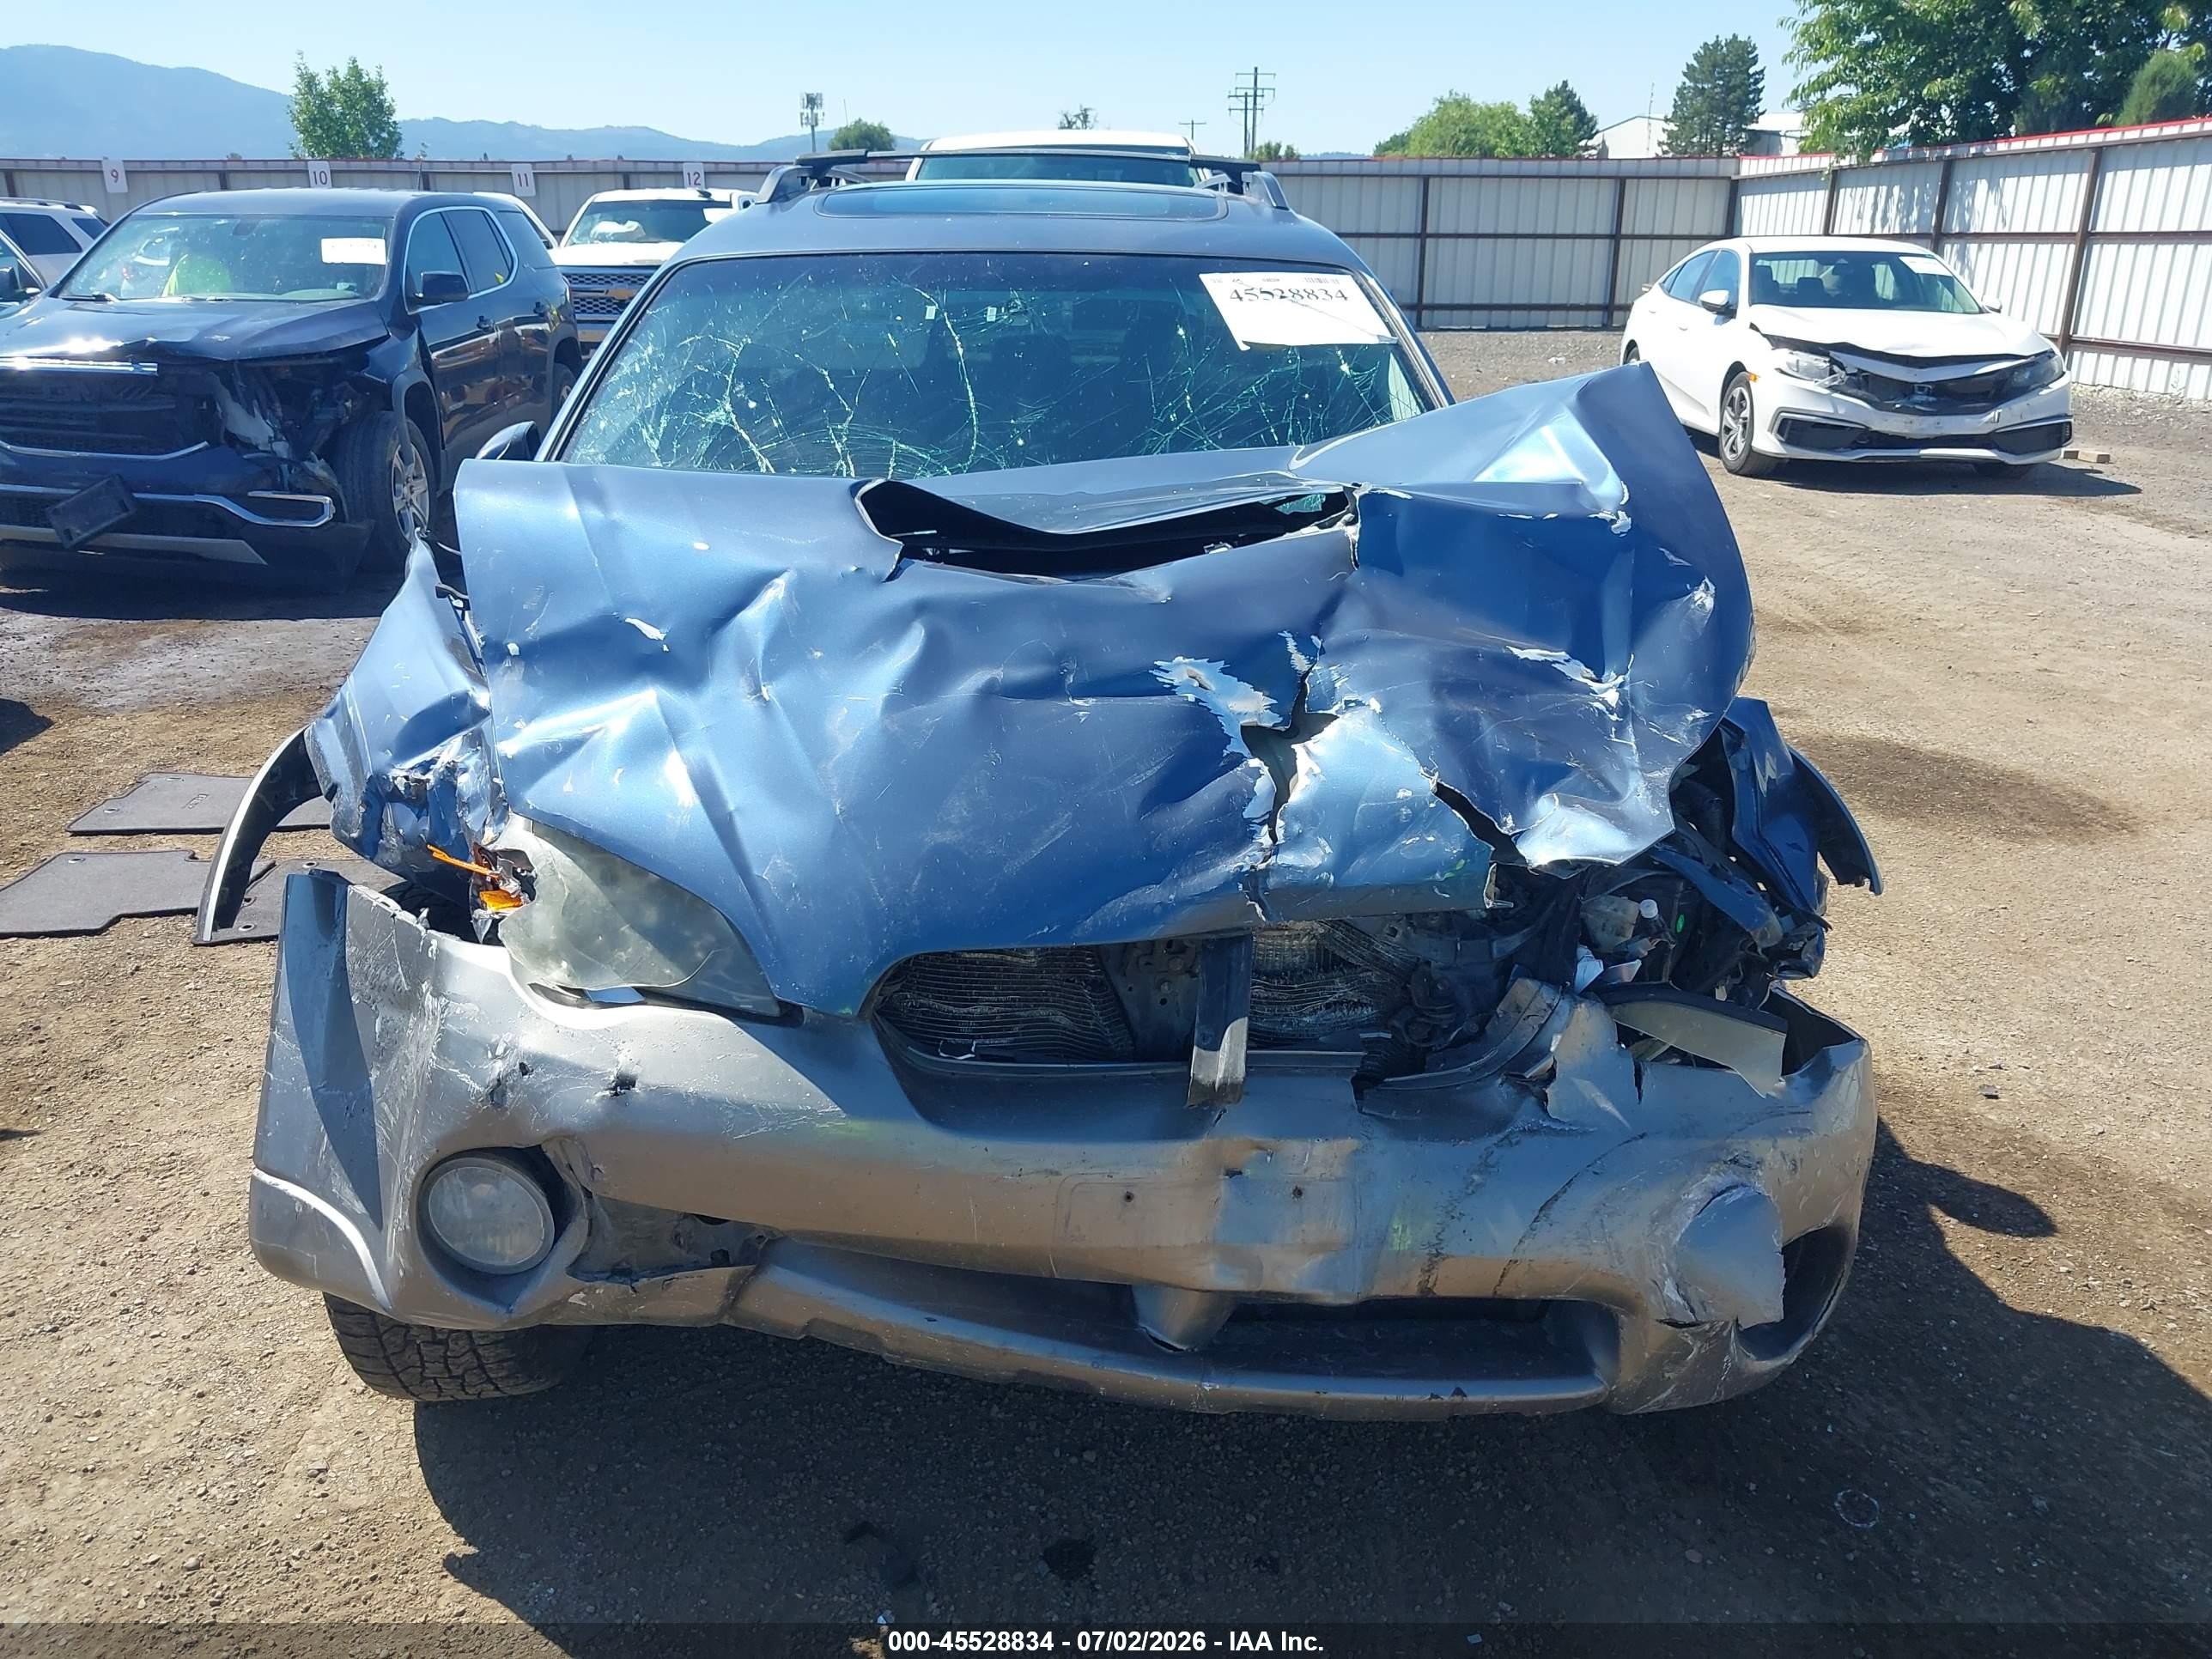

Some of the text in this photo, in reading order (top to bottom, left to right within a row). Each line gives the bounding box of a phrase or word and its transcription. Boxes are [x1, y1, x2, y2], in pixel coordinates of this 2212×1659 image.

[110, 168, 119, 184] 9
[313, 170, 328, 185] 10
[517, 172, 530, 188] 11
[686, 171, 702, 186] 12
[1230, 287, 1348, 302] 45528834
